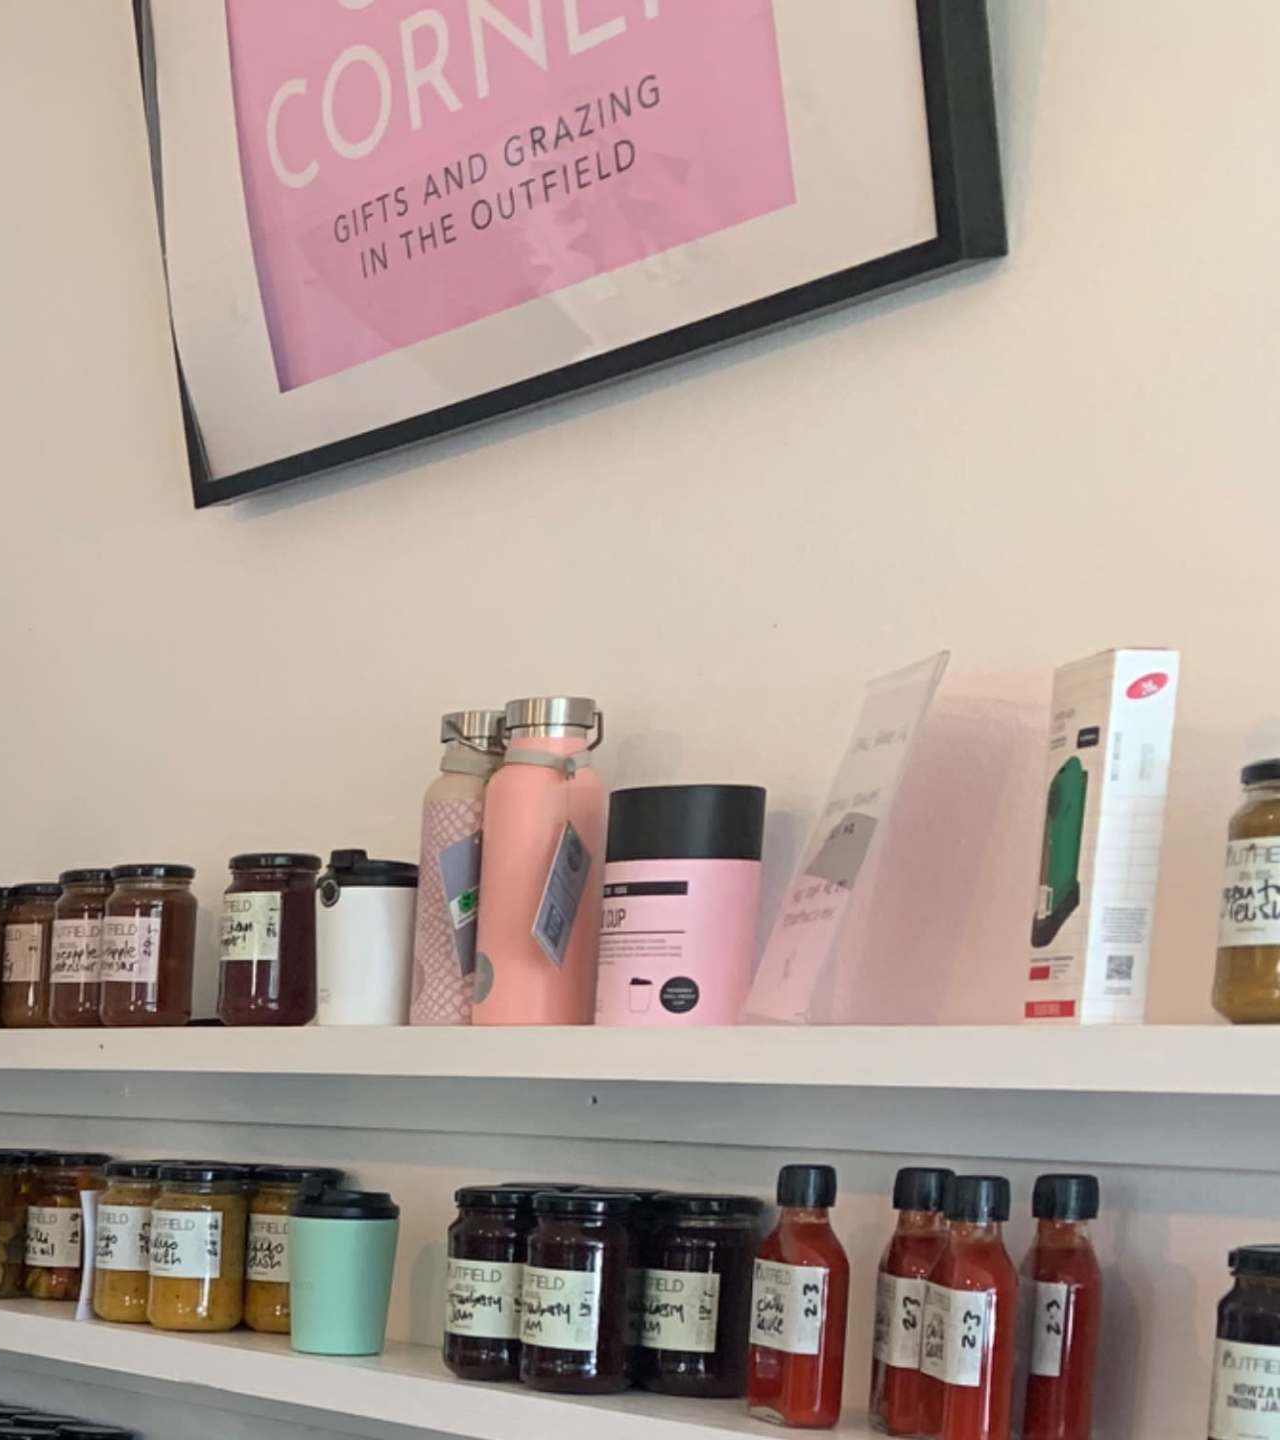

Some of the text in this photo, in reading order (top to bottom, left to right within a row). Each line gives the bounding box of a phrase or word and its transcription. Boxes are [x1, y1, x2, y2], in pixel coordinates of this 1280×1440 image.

[333, 74, 663, 245] GIFTS AND GRAZING
[359, 139, 638, 279] IN THE OUTFIELD
